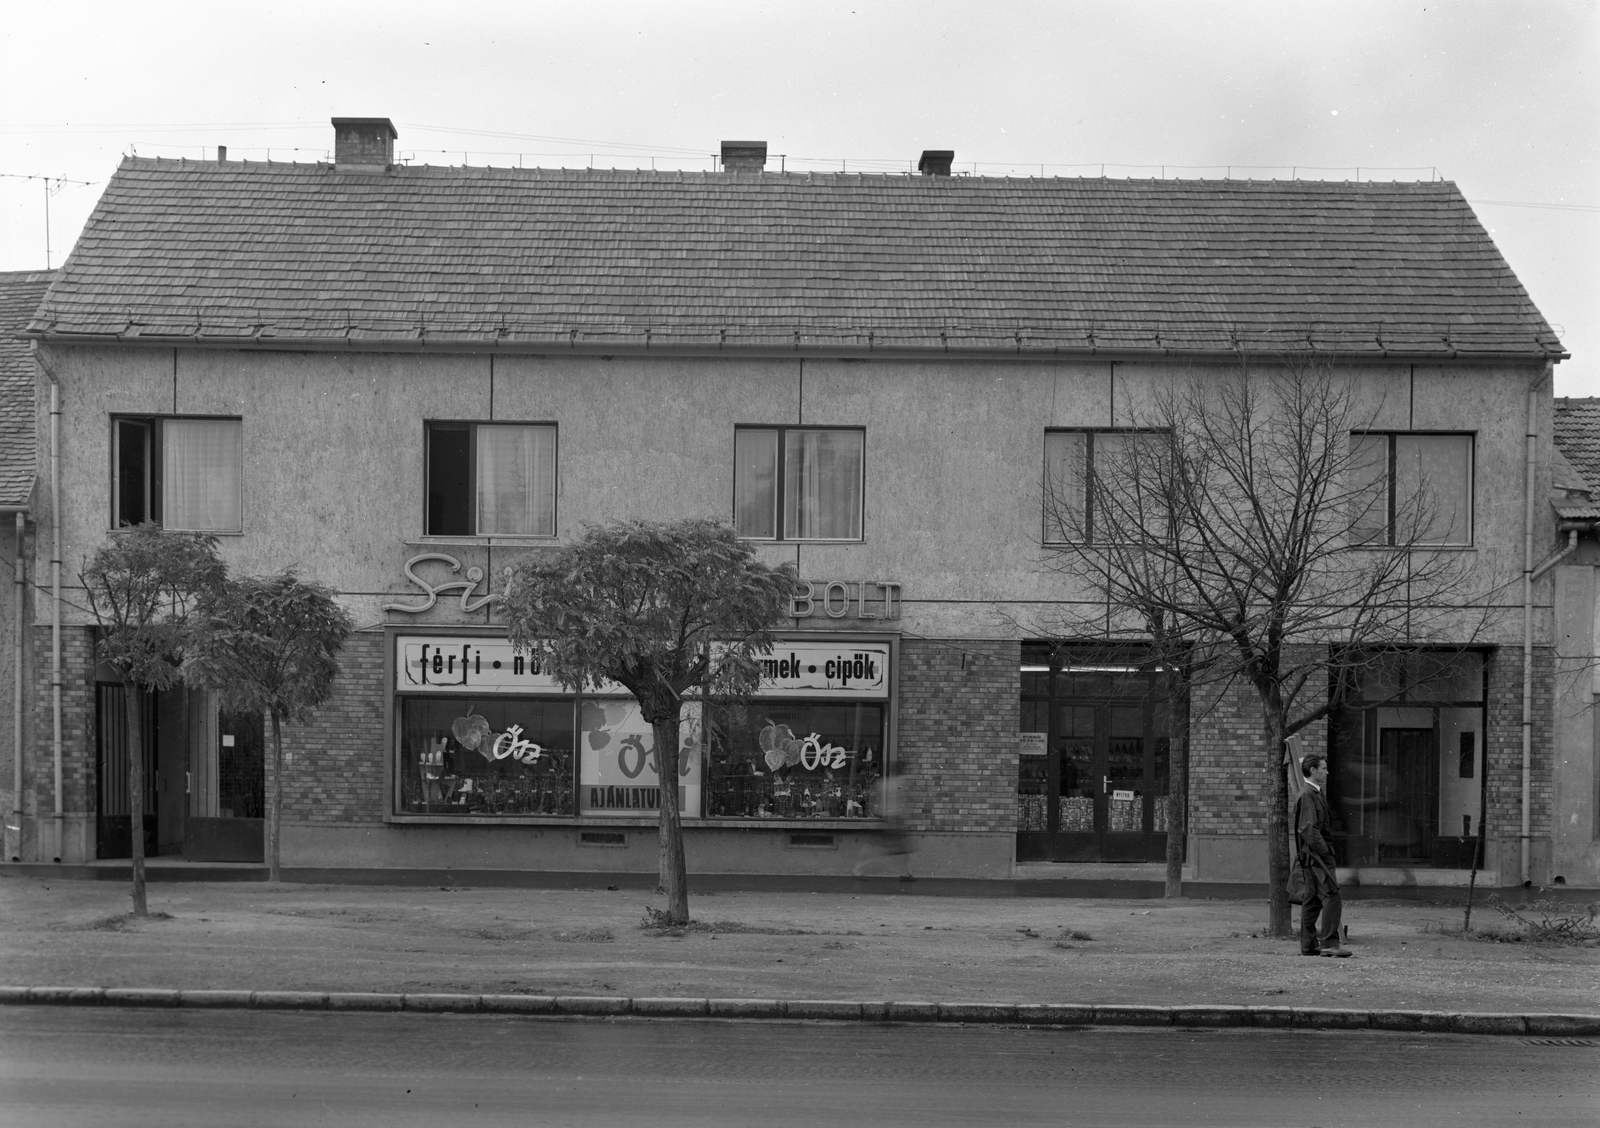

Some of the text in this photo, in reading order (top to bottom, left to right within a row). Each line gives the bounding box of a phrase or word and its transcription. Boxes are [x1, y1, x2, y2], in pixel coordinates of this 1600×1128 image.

[420, 643, 552, 685] férfi nő
[590, 785, 661, 809] AJÁNLATU
